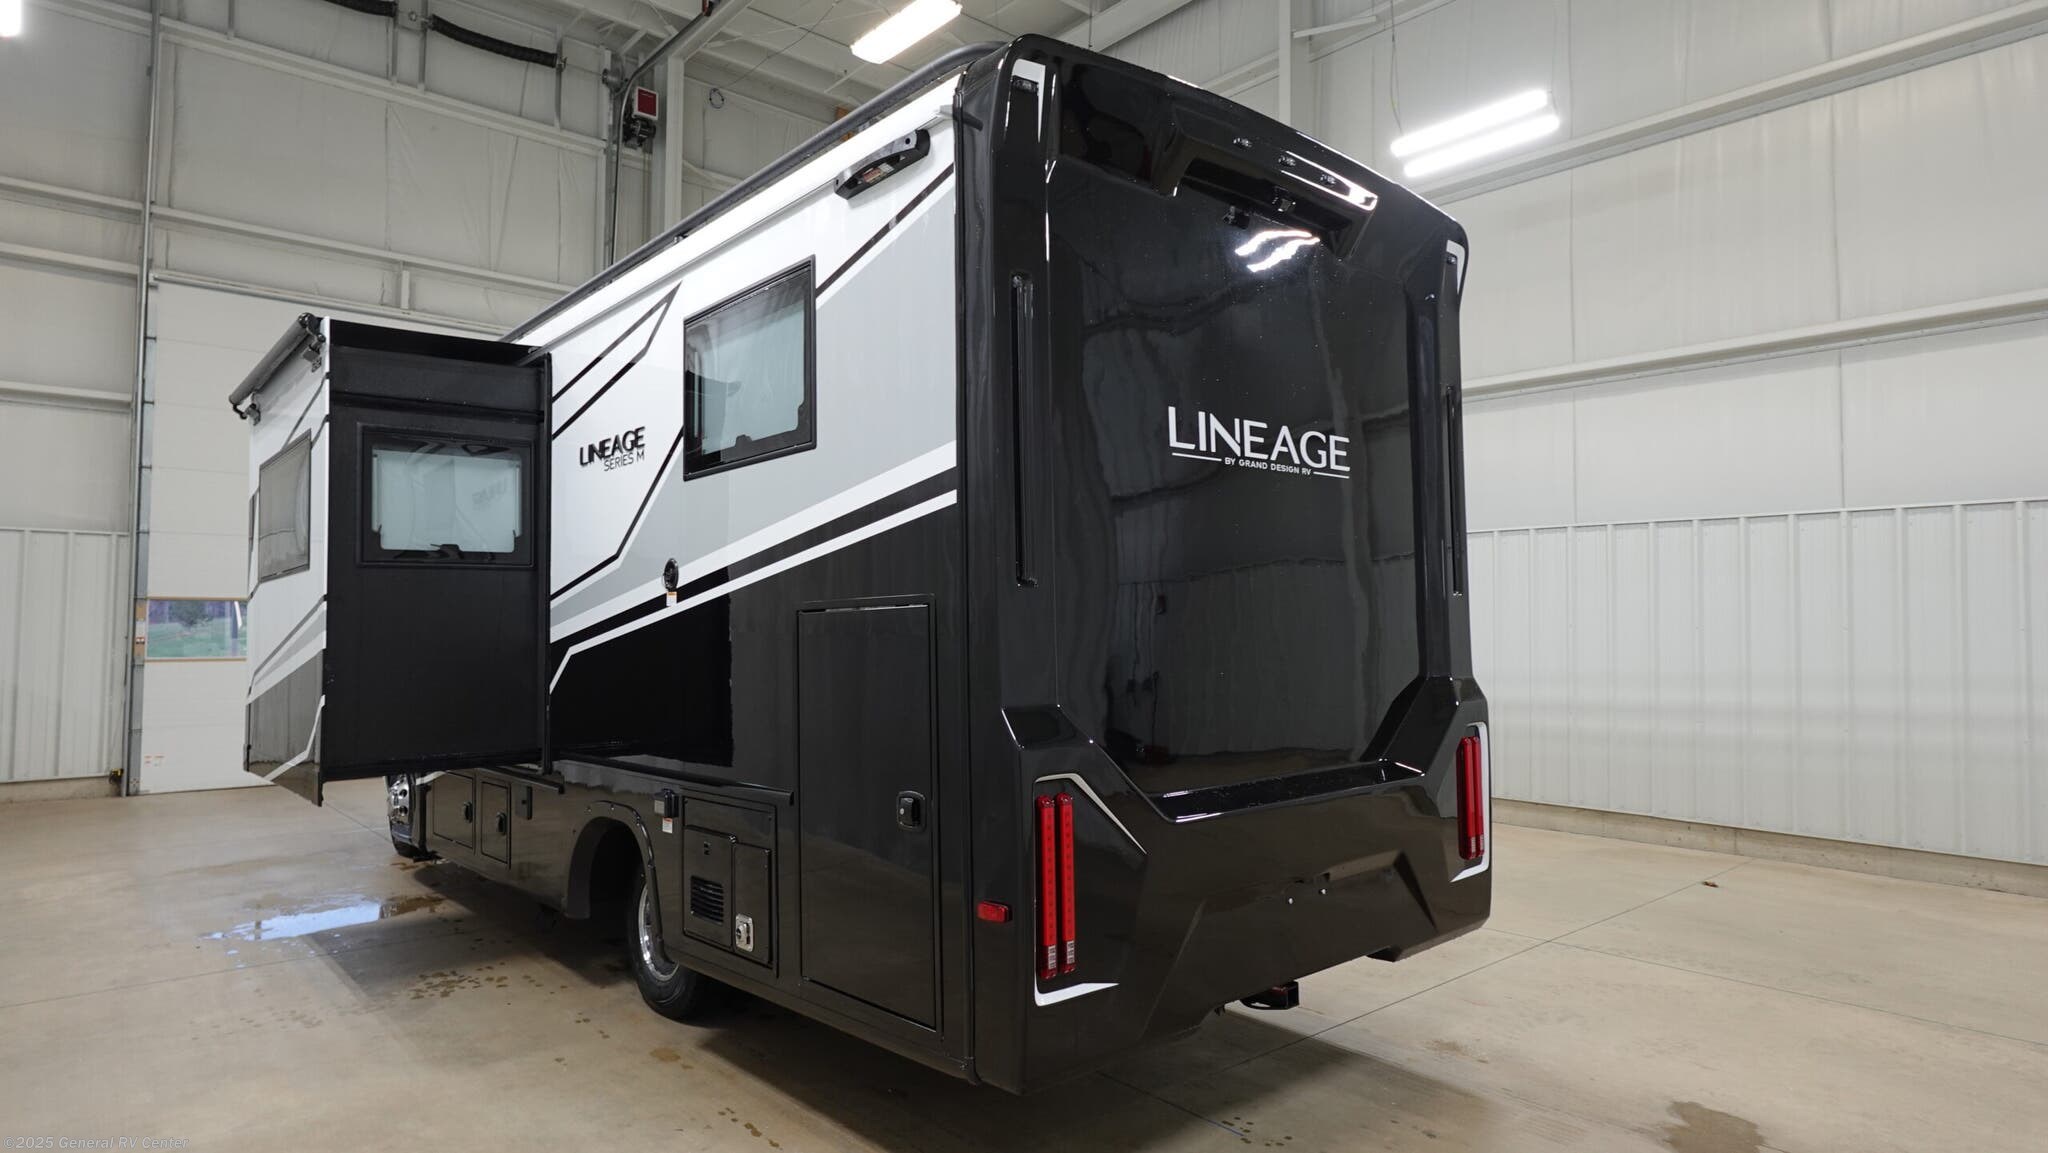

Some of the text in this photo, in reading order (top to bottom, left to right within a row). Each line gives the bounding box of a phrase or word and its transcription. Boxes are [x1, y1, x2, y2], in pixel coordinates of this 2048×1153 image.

[580, 426, 645, 467] LINEAGE
[1168, 406, 1350, 472] LINEAGE
[604, 450, 645, 471] SERIES M
[1224, 457, 1312, 476] BY GRAND DESIGN RV
